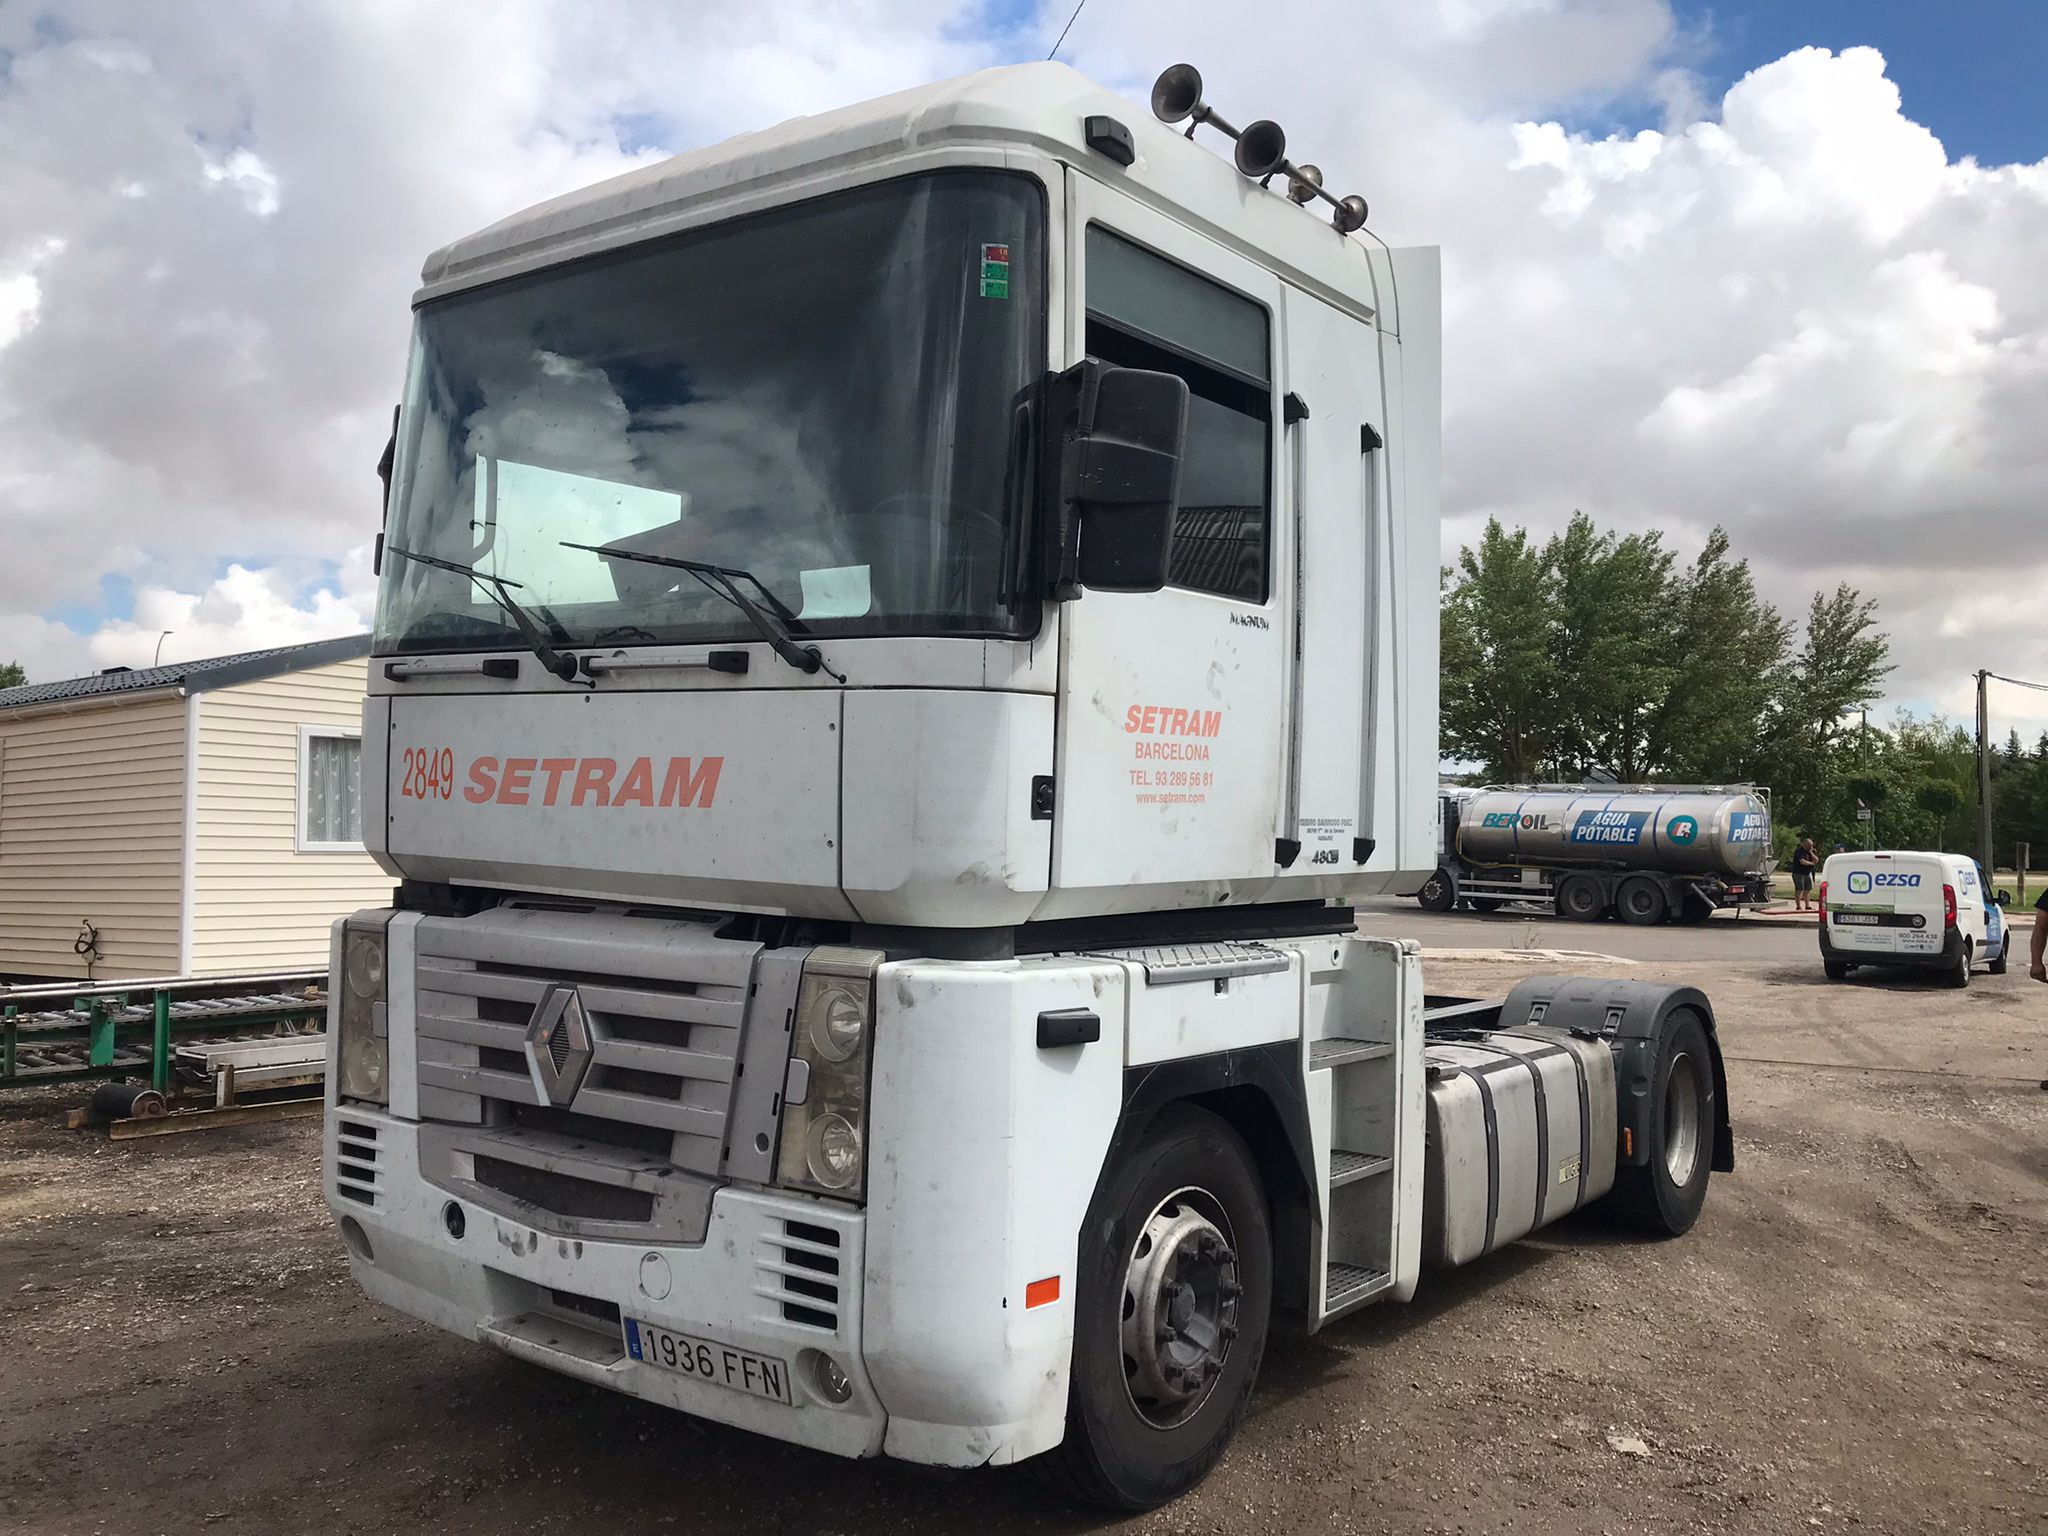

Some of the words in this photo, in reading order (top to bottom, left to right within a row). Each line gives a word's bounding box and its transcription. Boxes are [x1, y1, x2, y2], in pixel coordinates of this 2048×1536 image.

[1124, 704, 1222, 738] SETRAM
[1135, 741, 1210, 761] BARCELONA
[401, 747, 454, 801] 2849
[463, 756, 724, 808] SETRAM
[1129, 769, 1153, 786] TEL.
[1155, 771, 1168, 786] 93
[1169, 771, 1188, 786] 289
[1189, 772, 1201, 786] 56
[1203, 772, 1213, 787] 81
[1136, 792, 1205, 804] www.setram.com
[1591, 812, 1629, 826] AGUA
[1576, 826, 1637, 842] POTABLE
[1874, 873, 1921, 887] ezsa
[632, 1344, 639, 1353] E
[647, 1329, 715, 1378] 1936
[722, 1350, 782, 1398] FFN
